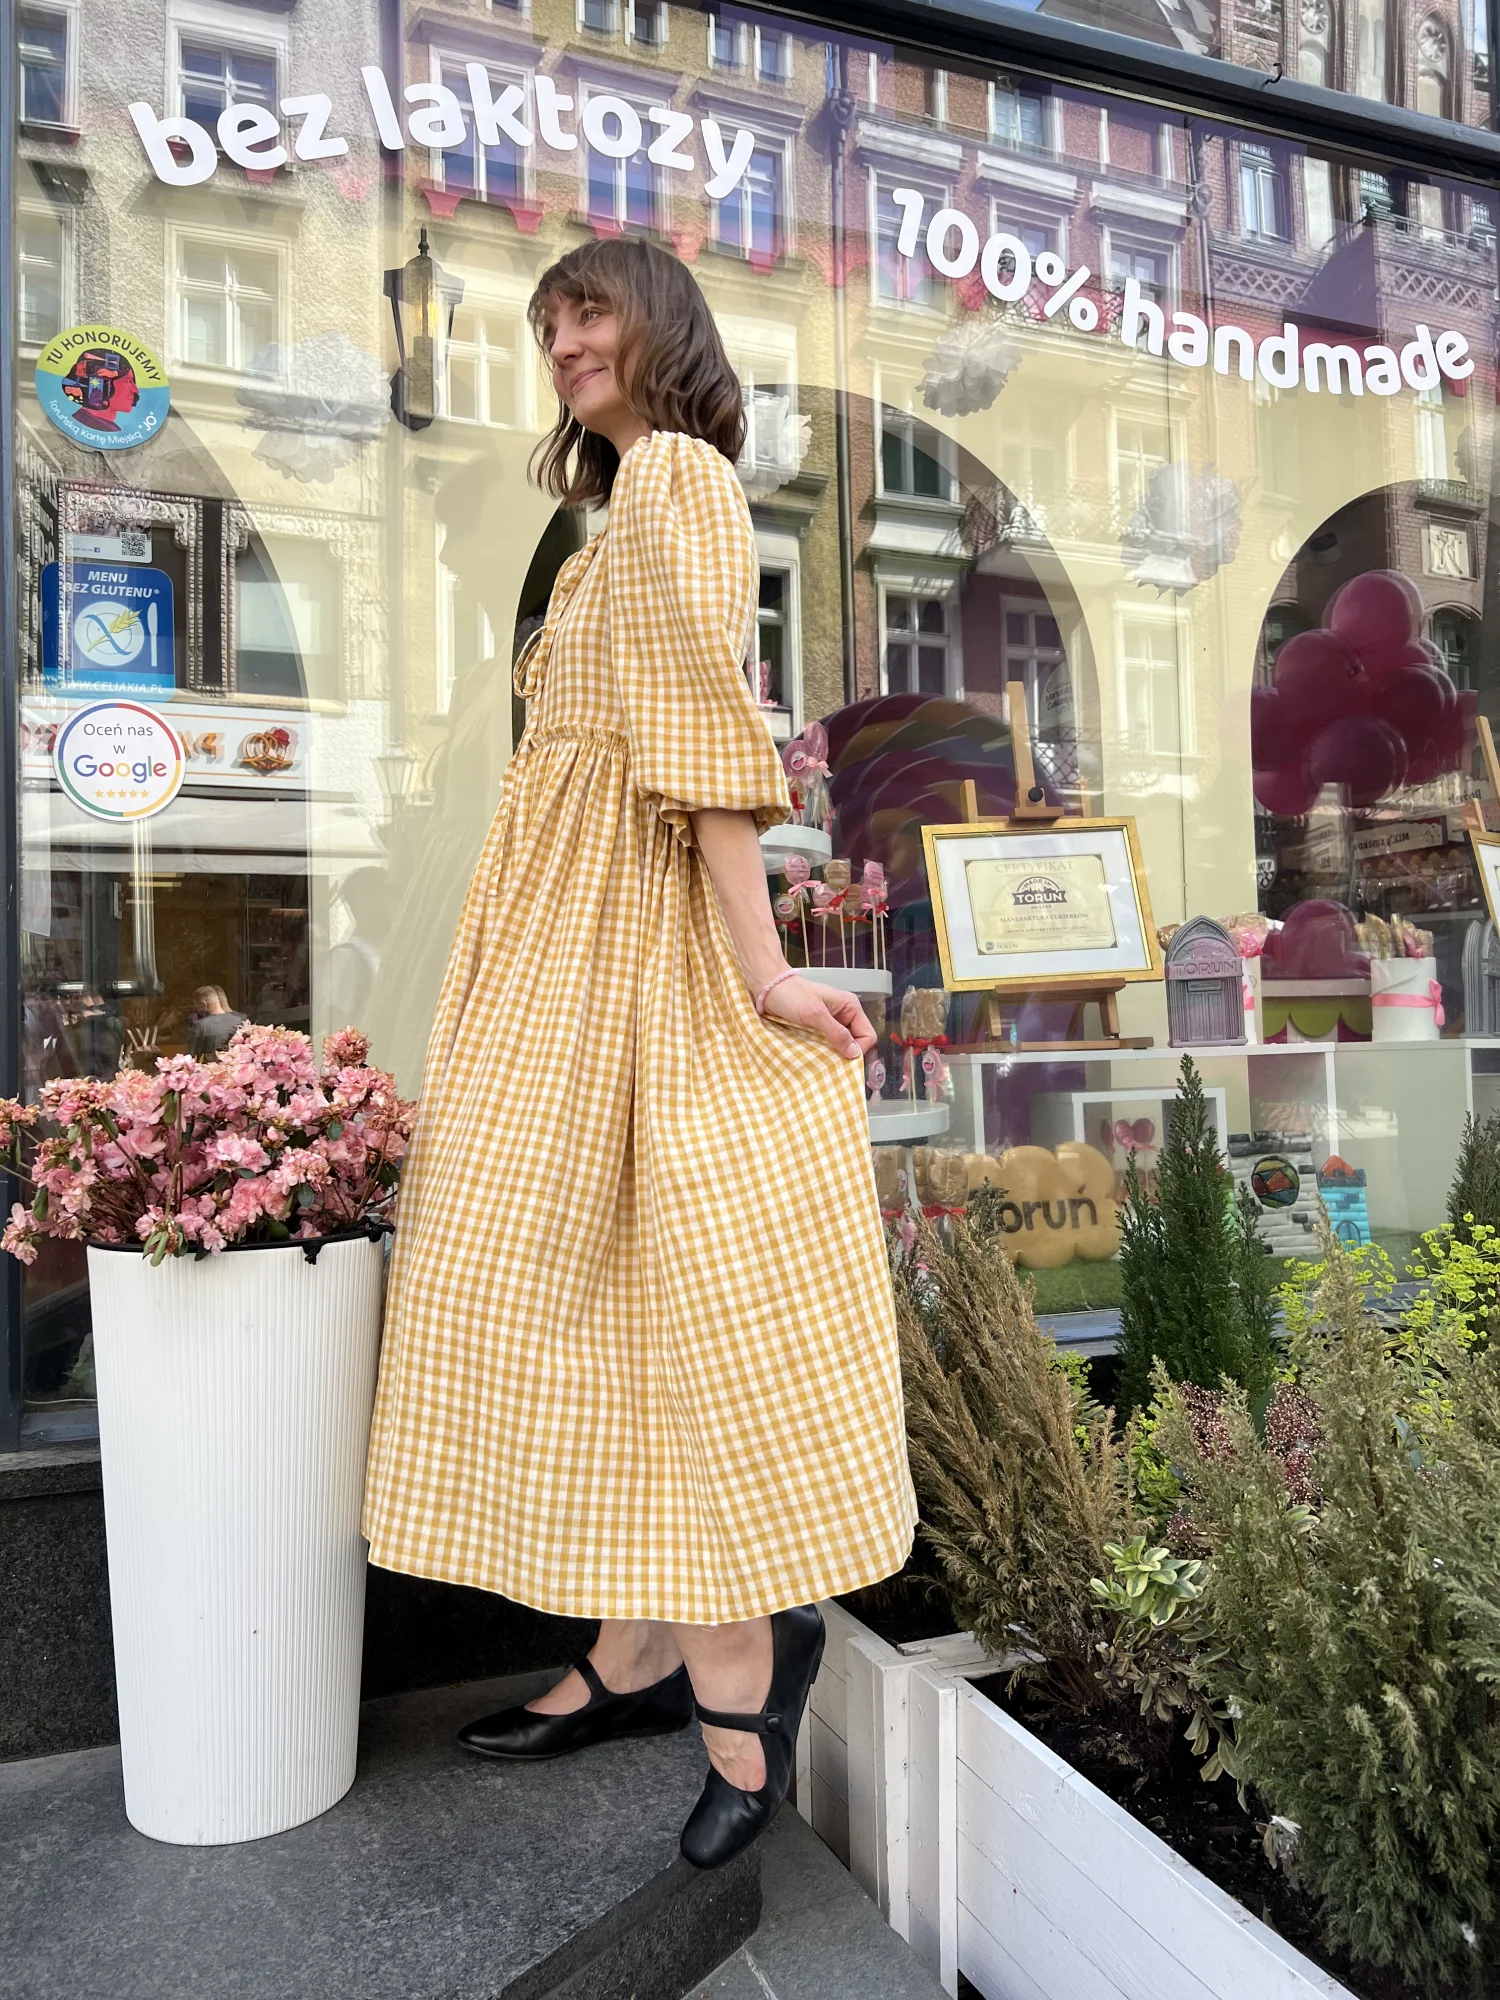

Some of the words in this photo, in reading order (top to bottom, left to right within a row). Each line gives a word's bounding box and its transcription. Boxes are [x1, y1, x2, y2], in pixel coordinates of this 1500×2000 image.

[127, 93, 349, 187] bez
[361, 62, 755, 199] laktozy
[892, 187, 1099, 331] 100%
[1120, 277, 1475, 396] handmade
[47, 348, 63, 365] TU
[61, 331, 161, 381] HONORUJEMY
[49, 399, 80, 435] Toruńską
[81, 429, 106, 445] Kartę
[108, 430, 143, 445] Miejską
[88, 571, 128, 583] MENU
[59, 679, 164, 694] WW.CELIAKIA.PL
[83, 723, 123, 737] Oceń
[128, 726, 153, 737] nas
[113, 745, 126, 754] w
[73, 754, 167, 783] Google
[995, 860, 1073, 873] CERTYFIKAT
[1024, 879, 1043, 888] MADE
[1000, 914, 1049, 923] MANUFAKTURA
